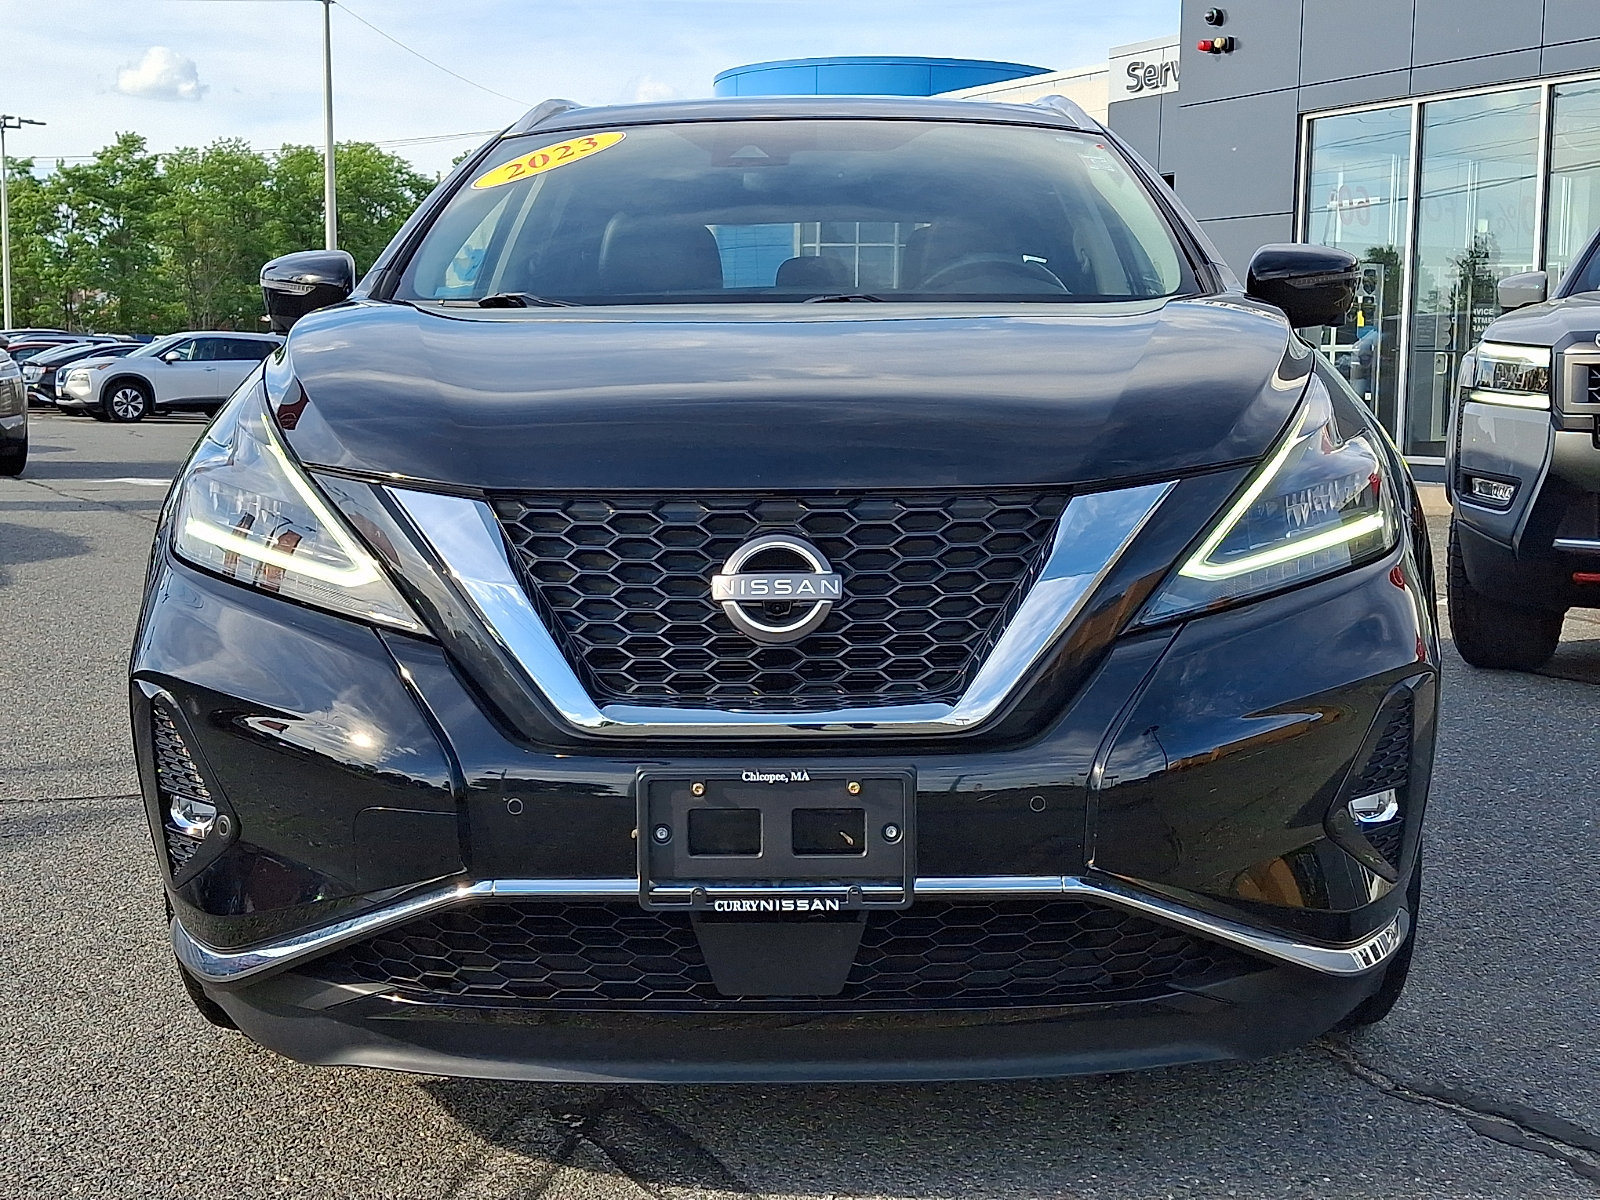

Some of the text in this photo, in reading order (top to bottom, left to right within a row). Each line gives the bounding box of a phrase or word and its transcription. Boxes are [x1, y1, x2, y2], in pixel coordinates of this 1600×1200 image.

[504, 137, 598, 180] 2023
[715, 579, 840, 595] NISSAN
[790, 771, 810, 781] MA
